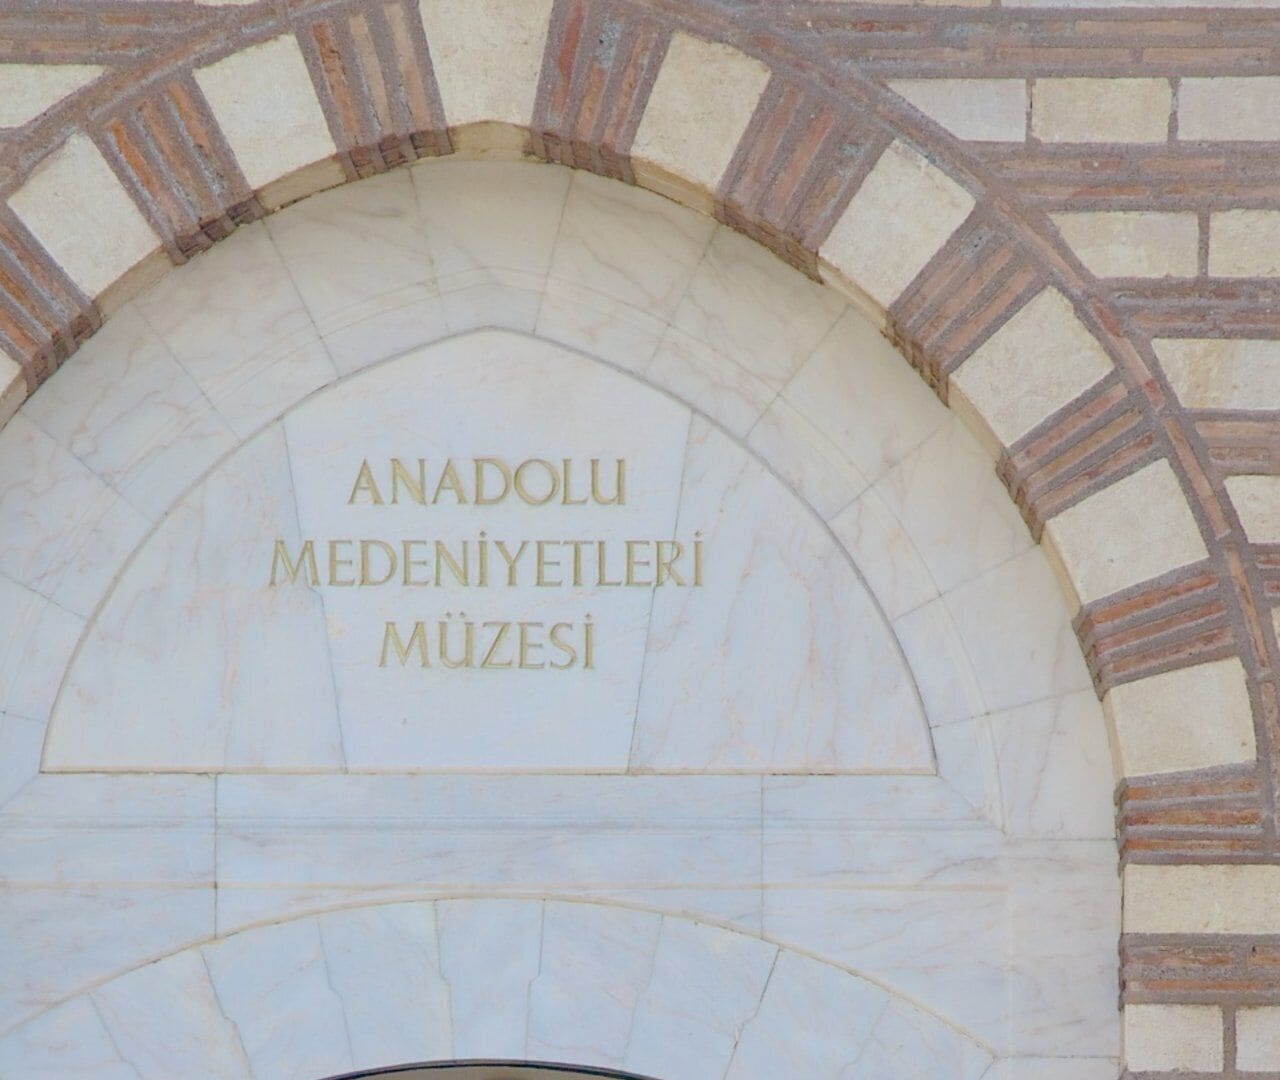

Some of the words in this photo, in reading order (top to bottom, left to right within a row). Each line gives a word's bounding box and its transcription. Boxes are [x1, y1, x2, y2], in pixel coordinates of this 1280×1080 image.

[347, 456, 627, 506] ANADOLU
[268, 530, 705, 588] MEDENİYETLERİ
[378, 611, 596, 670] MÜZESİ
